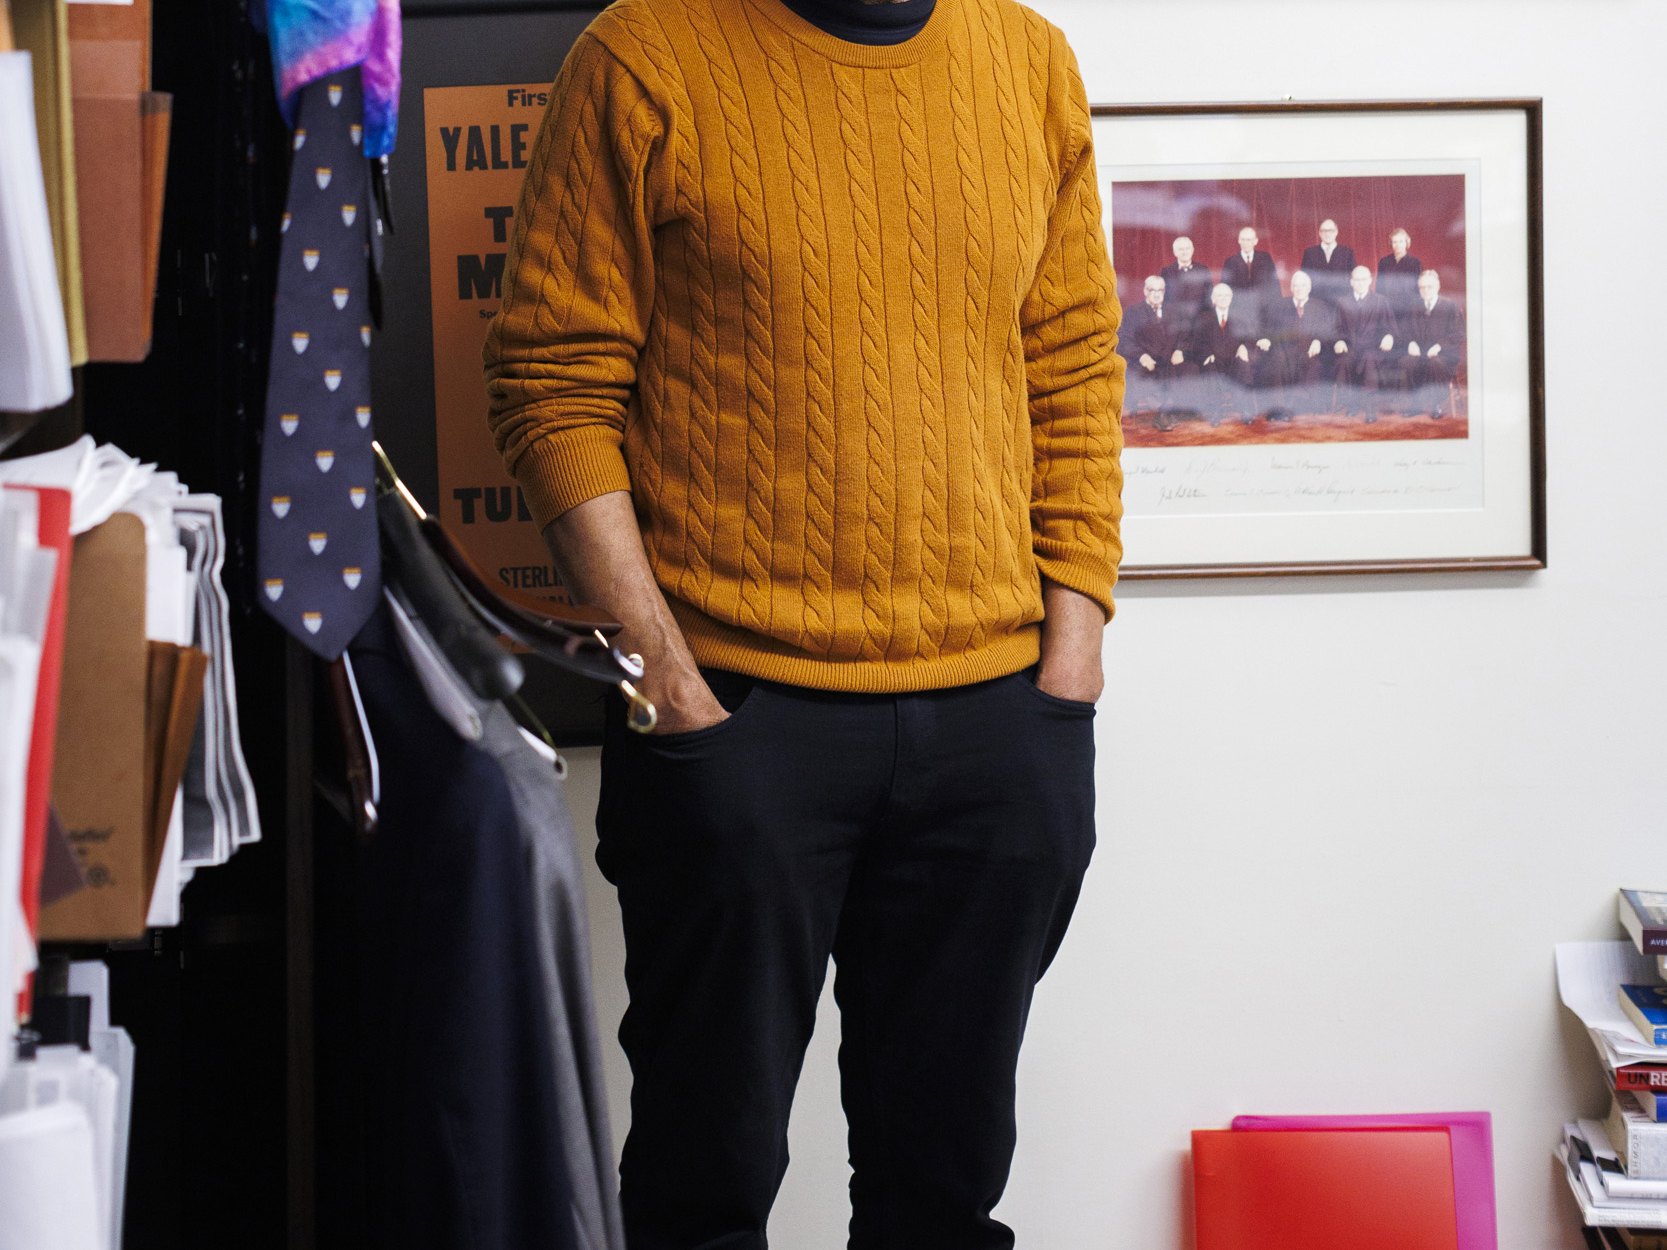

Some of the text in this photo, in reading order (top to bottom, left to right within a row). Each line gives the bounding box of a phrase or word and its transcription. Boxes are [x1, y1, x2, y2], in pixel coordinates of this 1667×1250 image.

[507, 89, 551, 107] Firs
[440, 124, 528, 171] YALE
[499, 566, 564, 588] STERLI
